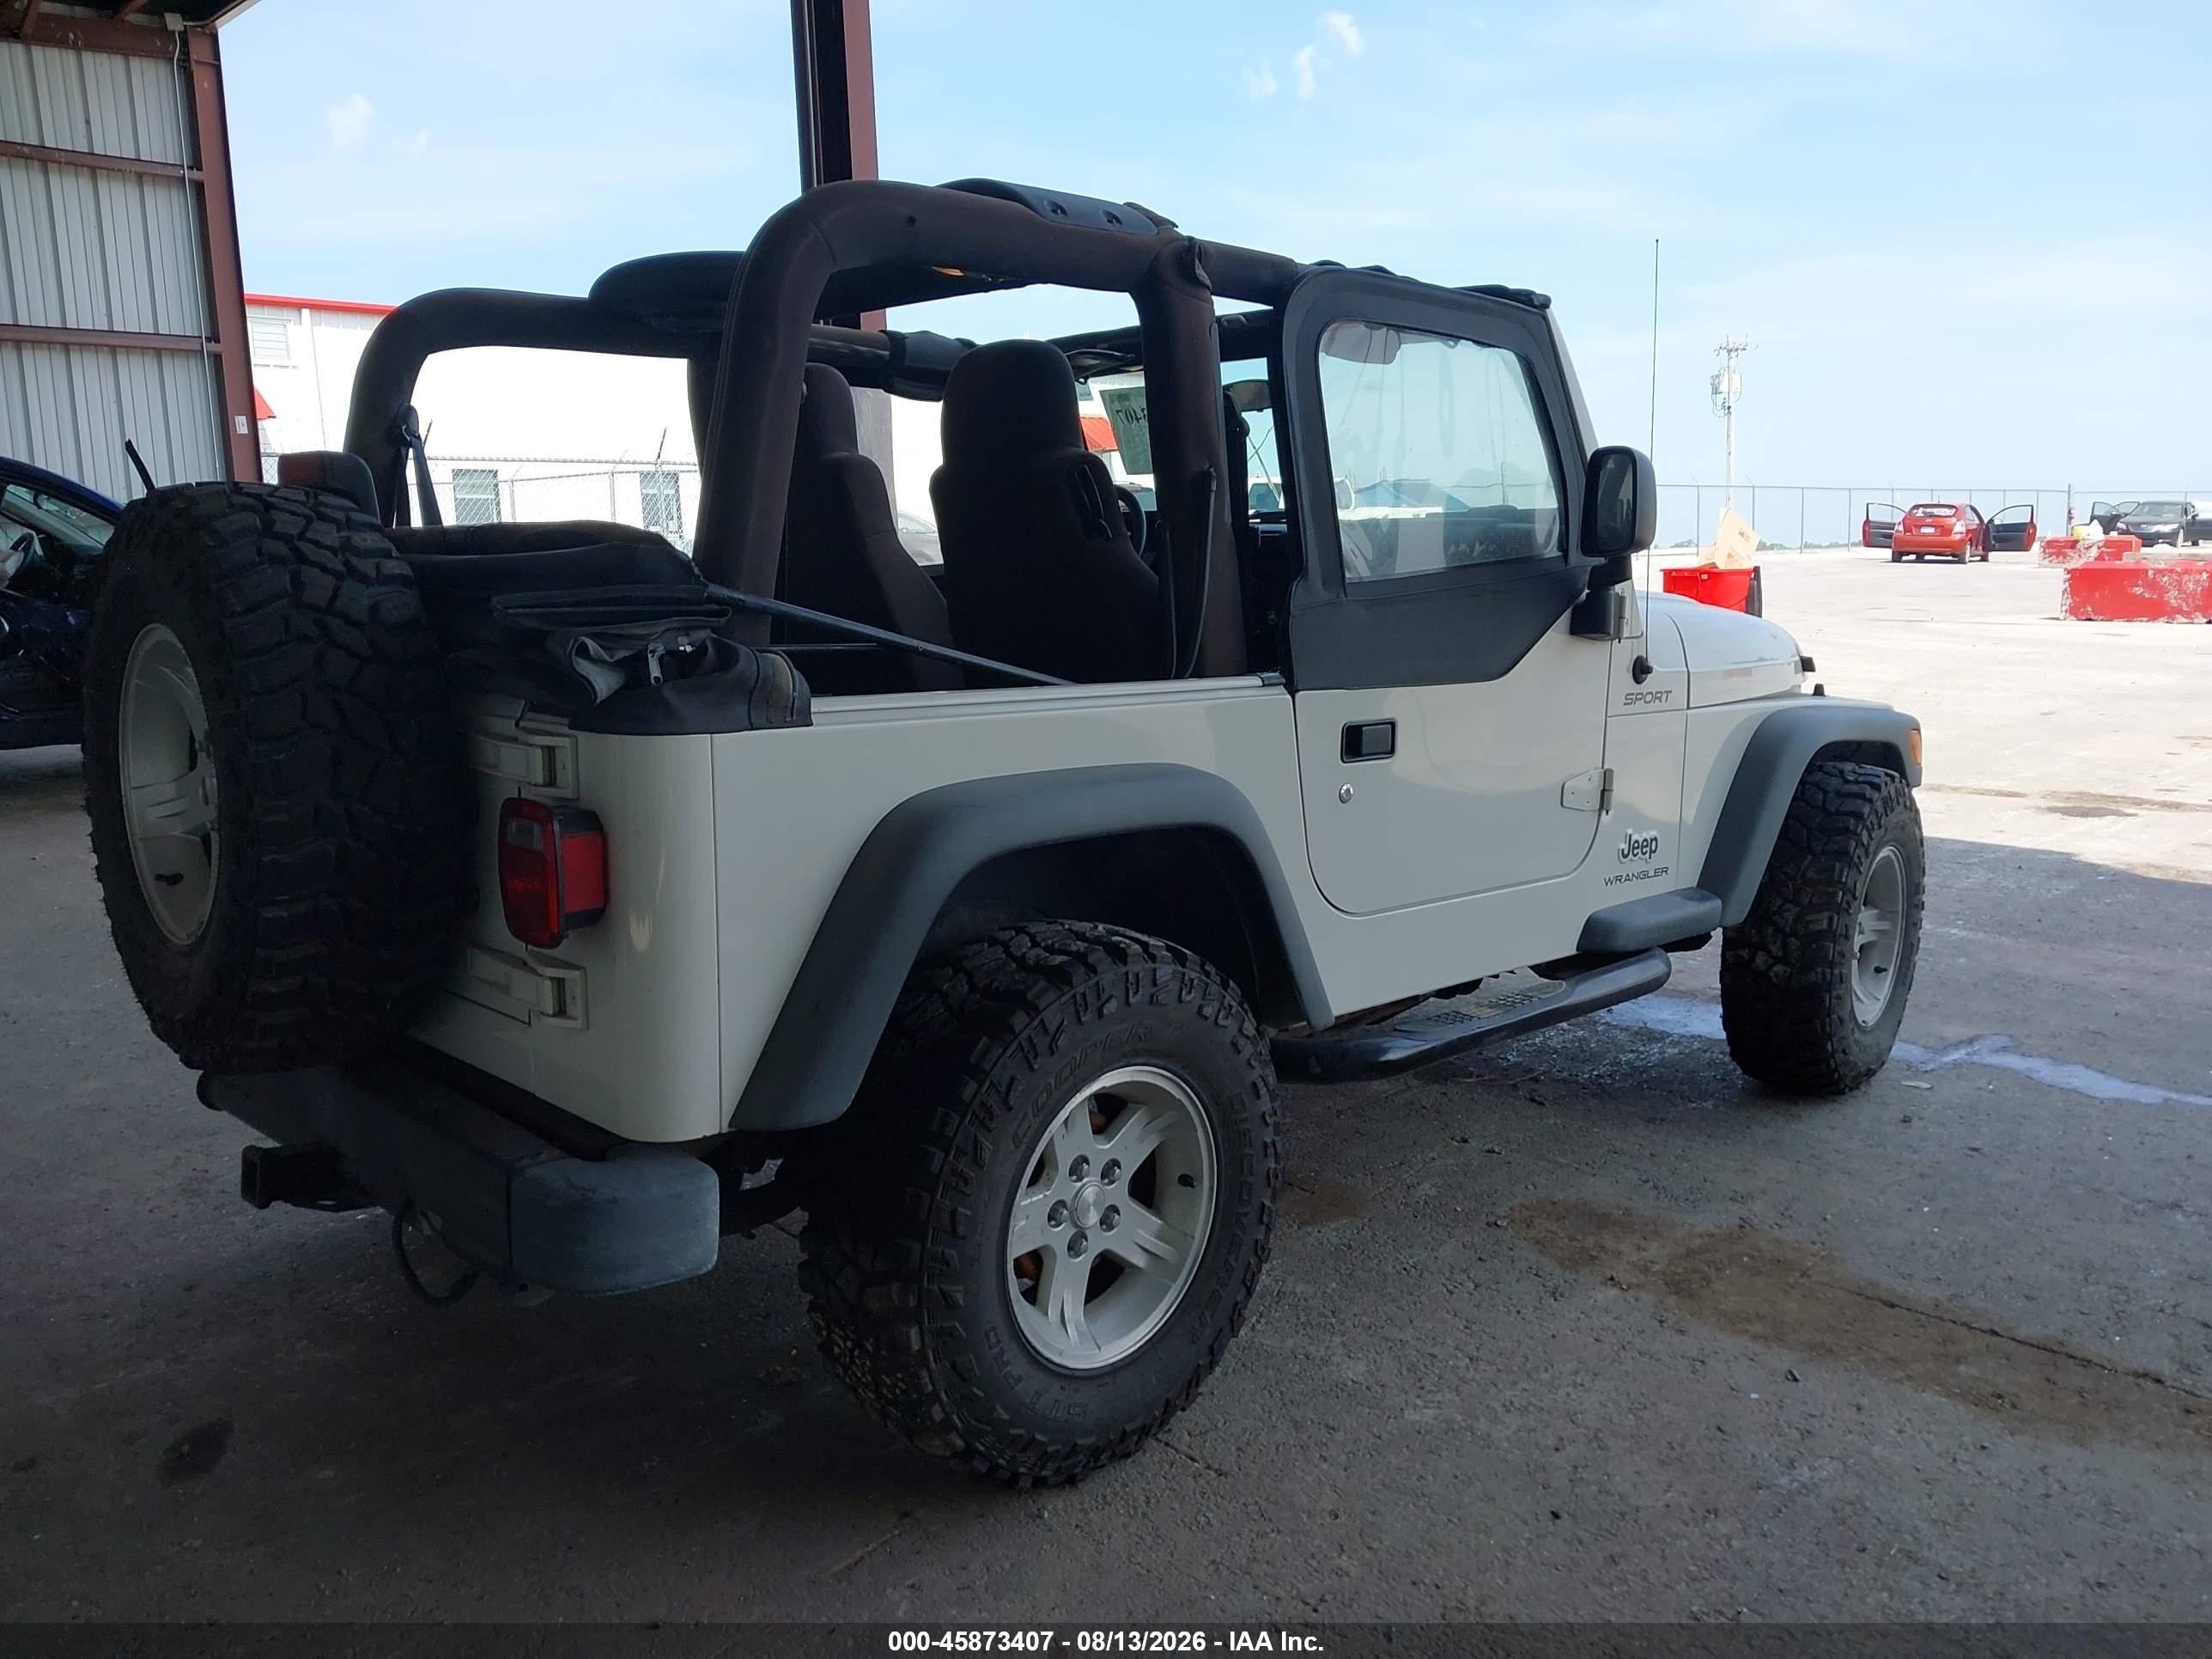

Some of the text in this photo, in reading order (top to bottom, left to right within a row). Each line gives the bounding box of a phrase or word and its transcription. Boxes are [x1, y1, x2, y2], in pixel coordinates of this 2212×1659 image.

[1623, 690, 1673, 706] SPORT
[1620, 832, 1658, 860] Jeep
[1603, 866, 1669, 887] WRANGLER
[1011, 1021, 1153, 1149] COOPER
[1190, 1091, 1255, 1346] DISCOVERER
